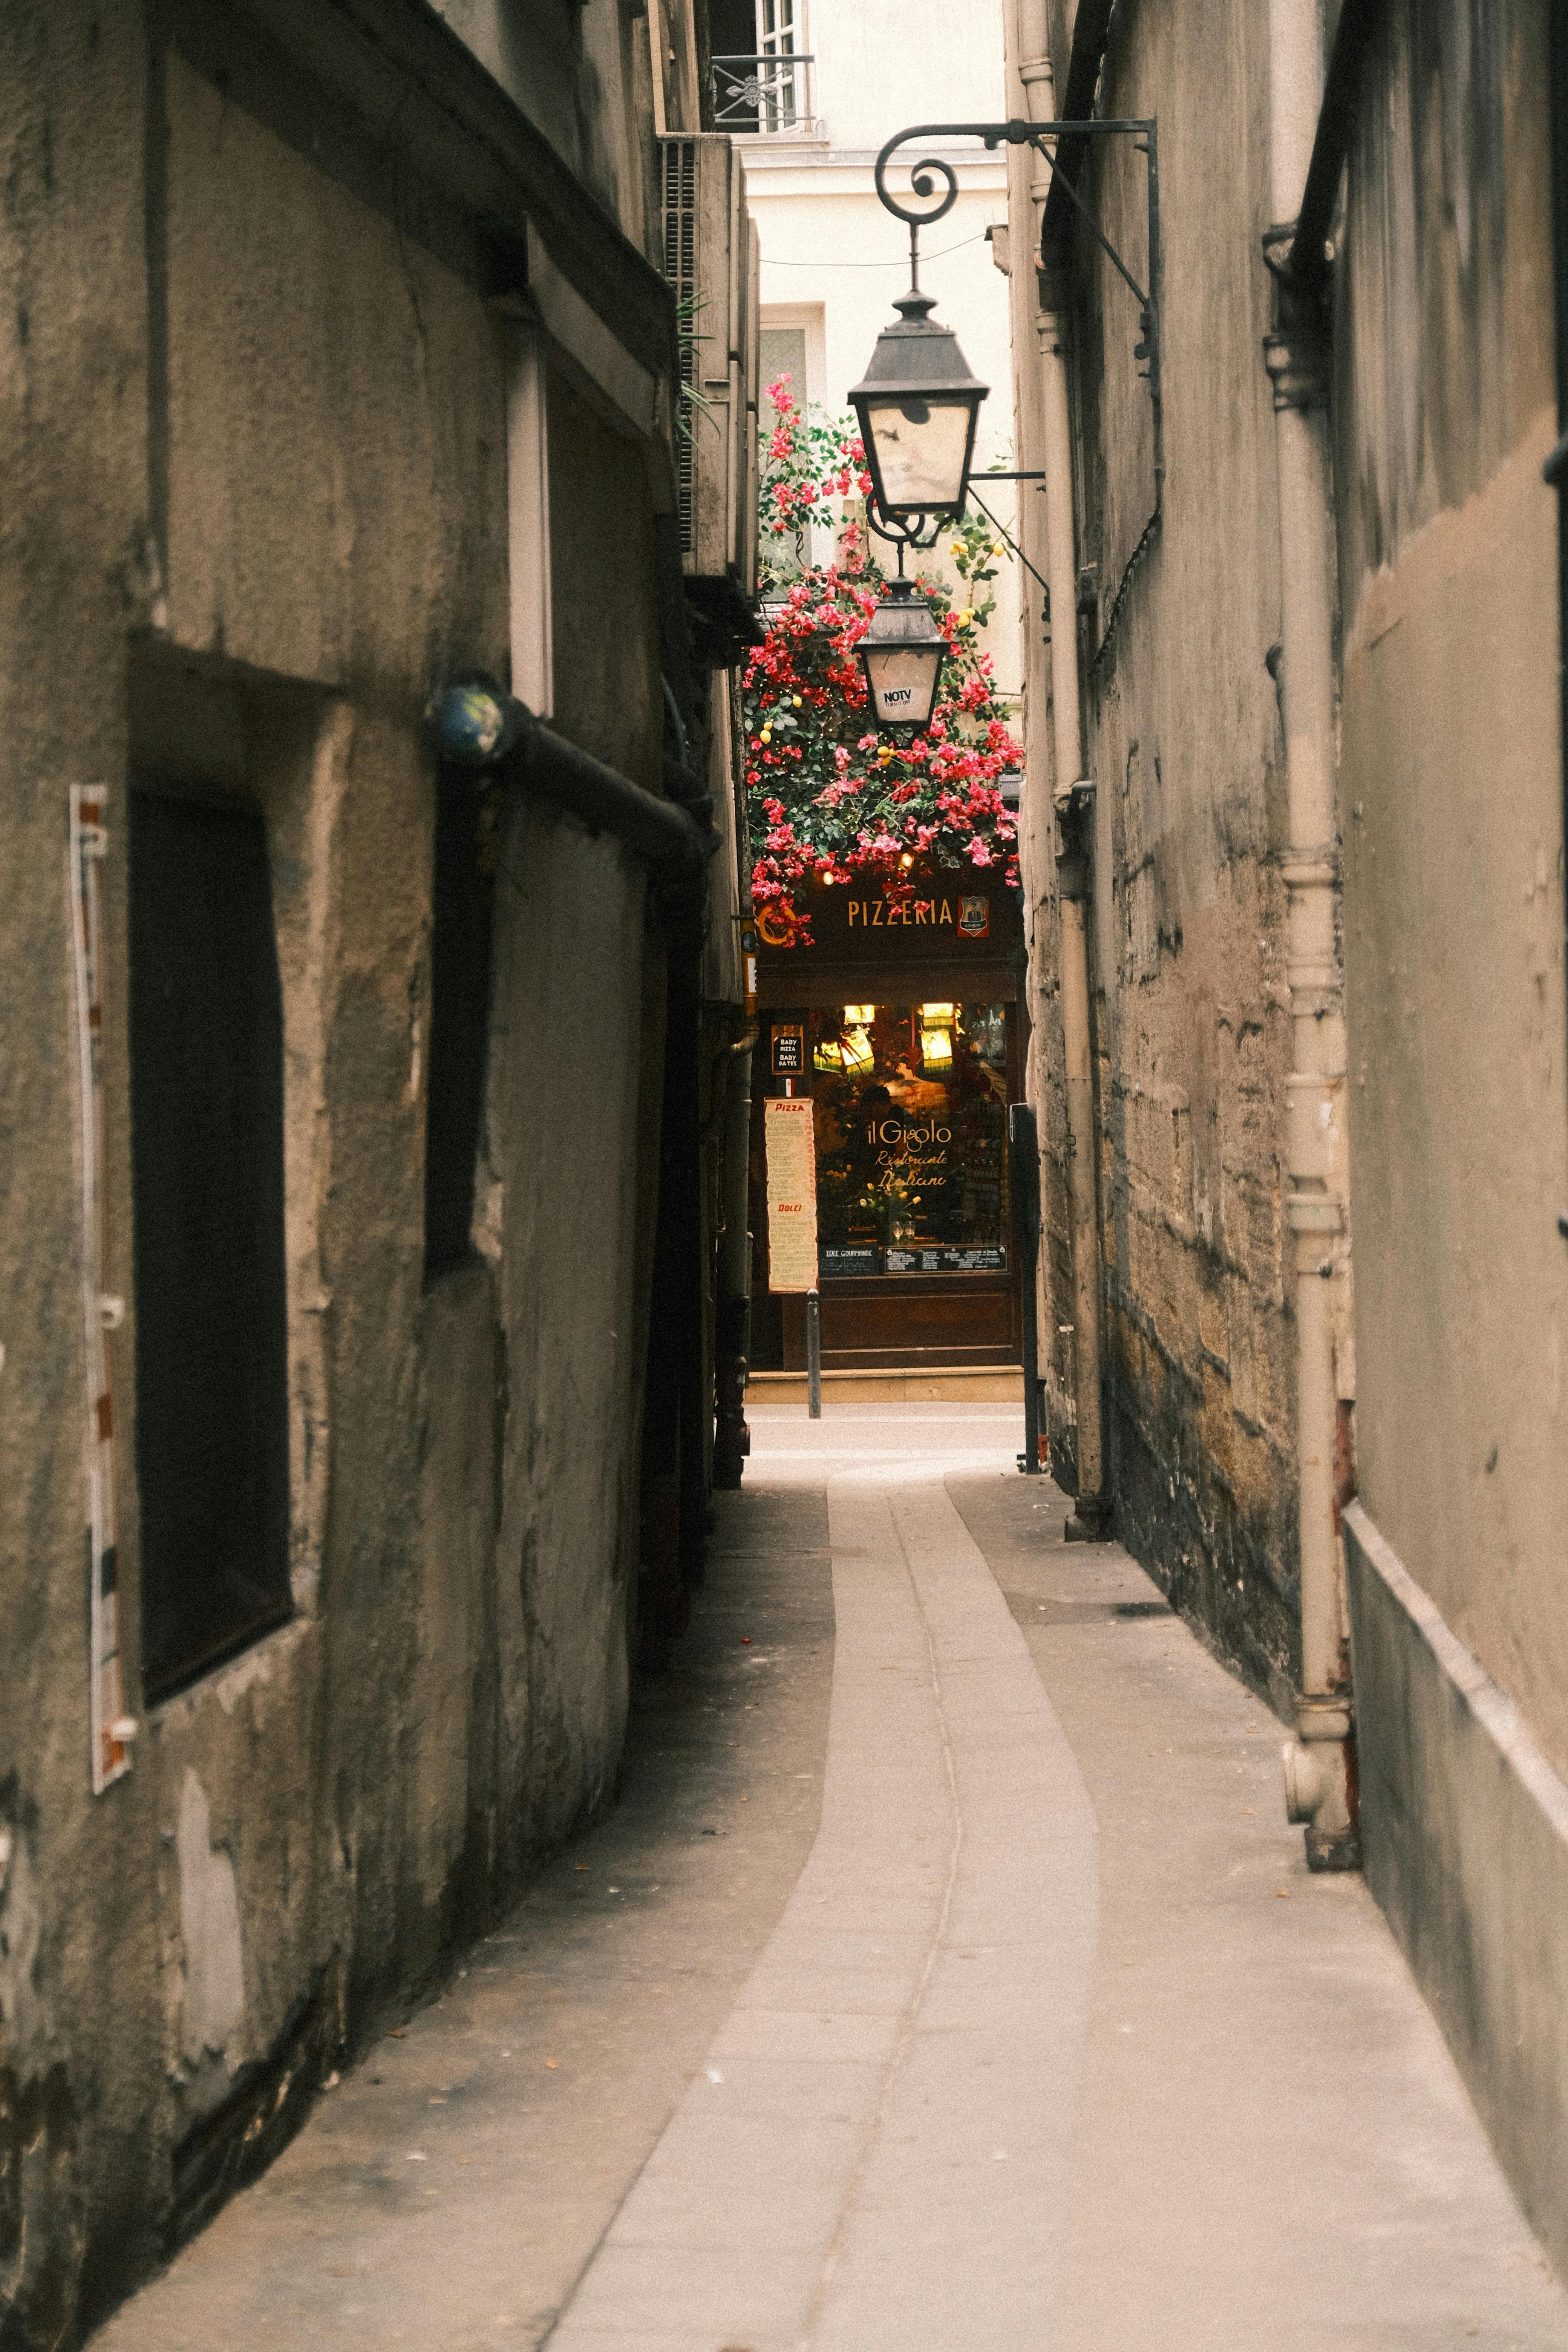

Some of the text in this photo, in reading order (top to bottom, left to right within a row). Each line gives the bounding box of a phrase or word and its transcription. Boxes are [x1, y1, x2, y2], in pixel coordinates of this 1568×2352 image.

[848, 899, 952, 926] PIZZERIA
[775, 1103, 804, 1112] PIZZA
[875, 1150, 947, 1166] Ristorante
